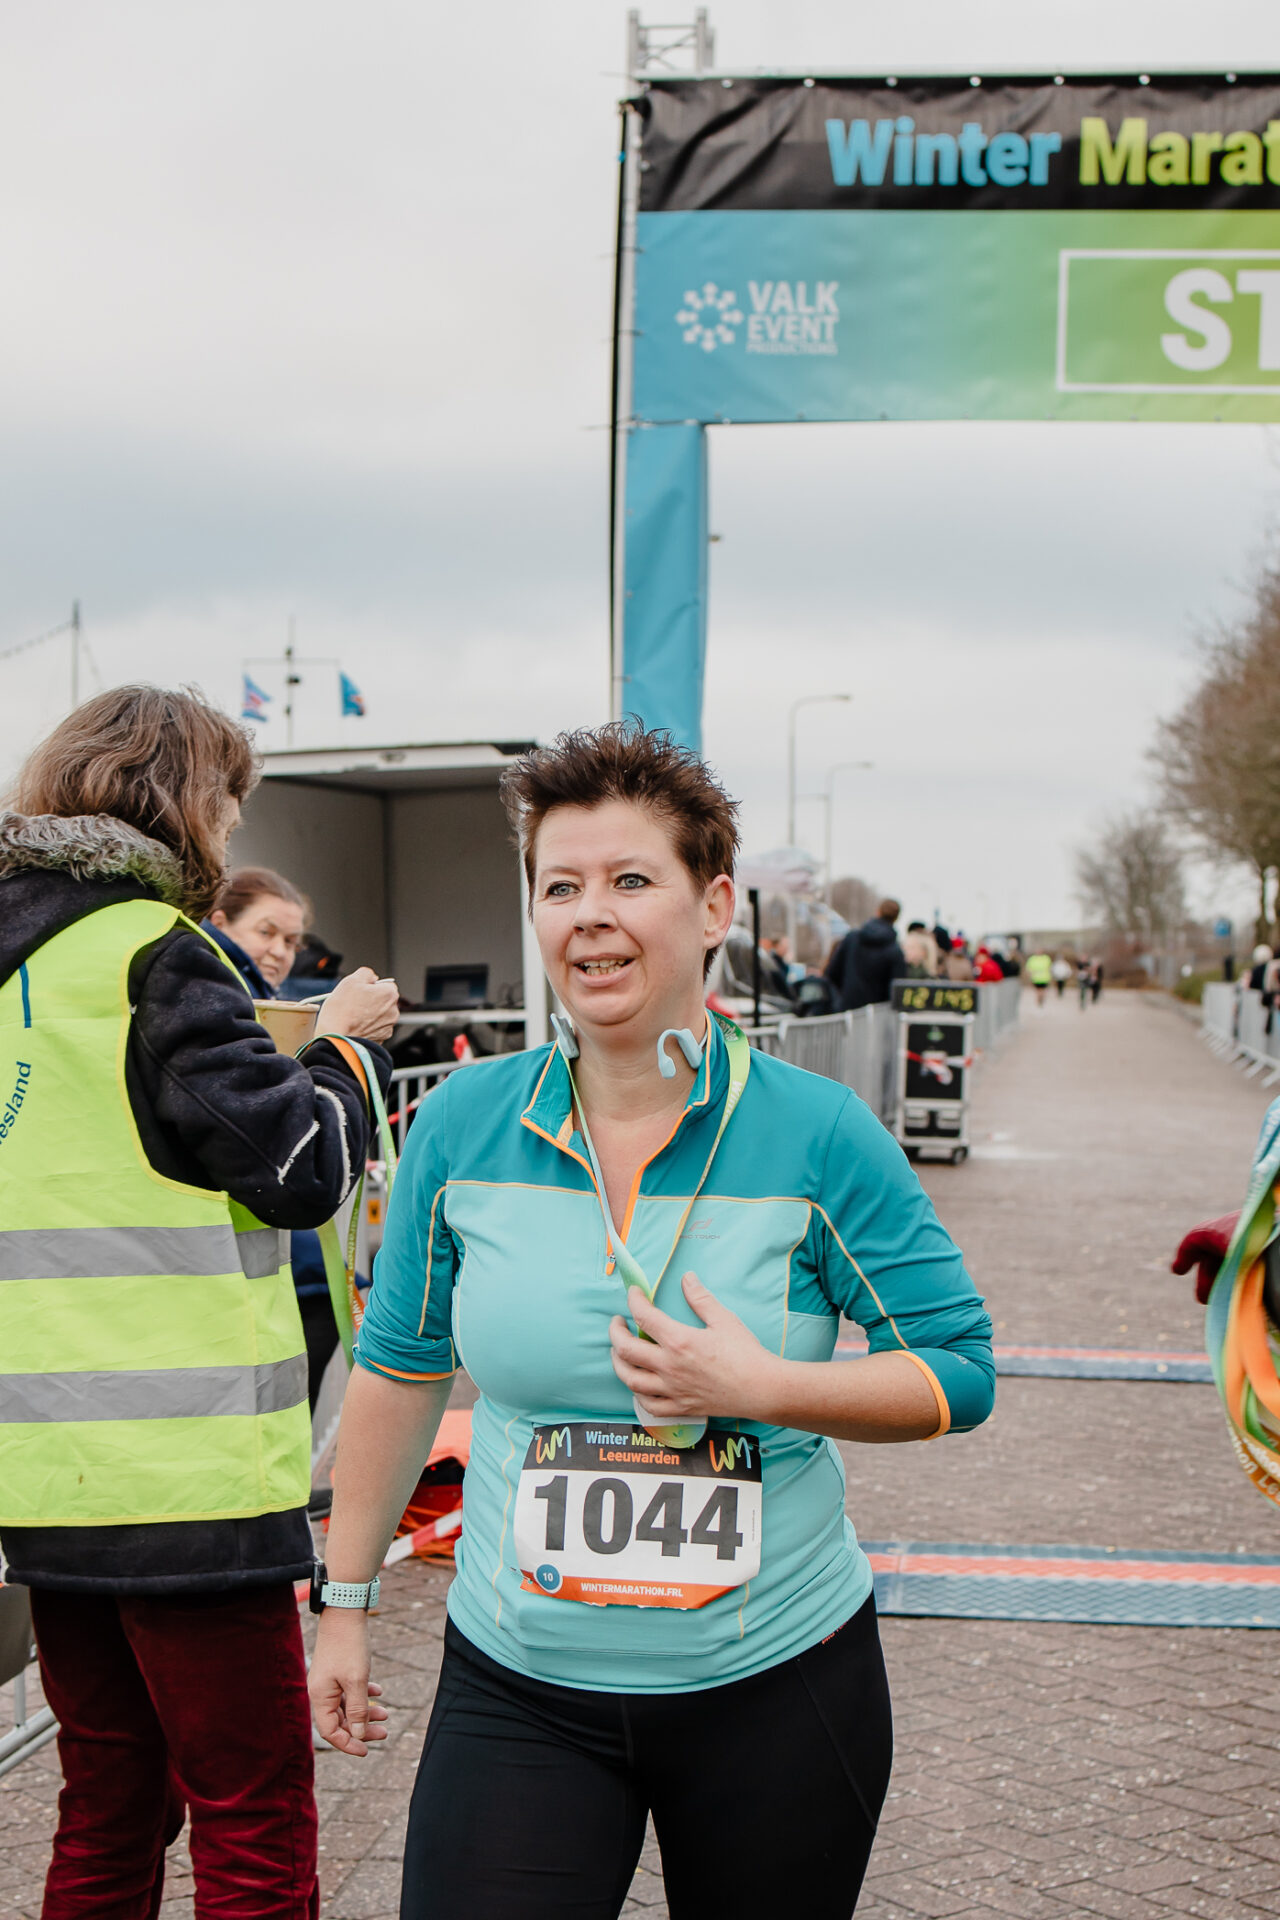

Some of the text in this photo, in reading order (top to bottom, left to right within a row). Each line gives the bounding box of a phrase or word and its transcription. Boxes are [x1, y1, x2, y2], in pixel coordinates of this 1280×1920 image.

[825, 116, 1280, 186] Winter Marat
[748, 281, 839, 313] VALK
[748, 314, 839, 341] EVENT
[0, 1061, 31, 1144] esland
[585, 1430, 628, 1446] Winter
[599, 1447, 680, 1465] Leeuwarden
[534, 1475, 743, 1561] 1044
[542, 1572, 554, 1582] 10
[580, 1582, 684, 1597] WINTERMARATHON.FRL
